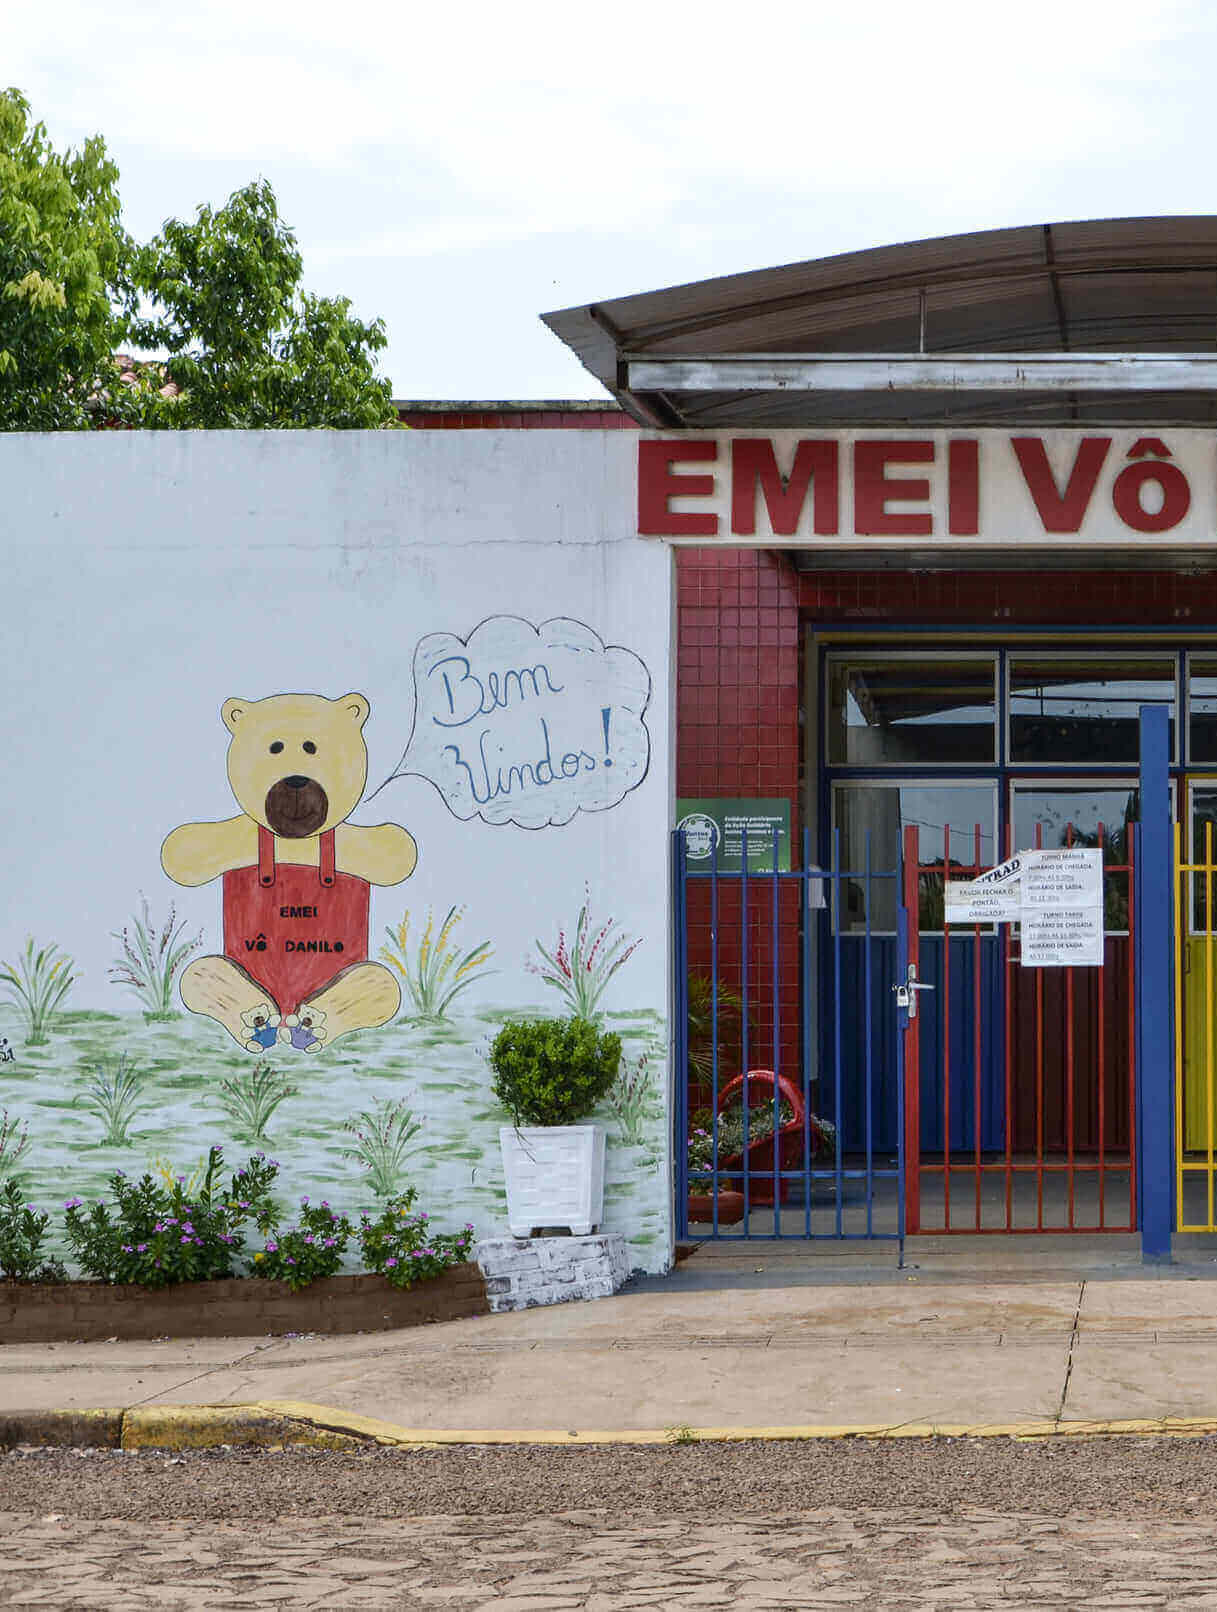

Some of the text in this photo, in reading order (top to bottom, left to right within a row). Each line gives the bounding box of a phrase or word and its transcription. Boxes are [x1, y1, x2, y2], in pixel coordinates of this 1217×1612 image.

[638, 438, 980, 536] EMEI
[1010, 437, 1191, 533] Vô
[427, 656, 565, 727] Bem
[444, 706, 612, 804] Vindos!
[975, 859, 1021, 884] TRAD
[280, 905, 318, 918] EMEI
[285, 939, 344, 953] DANILO
